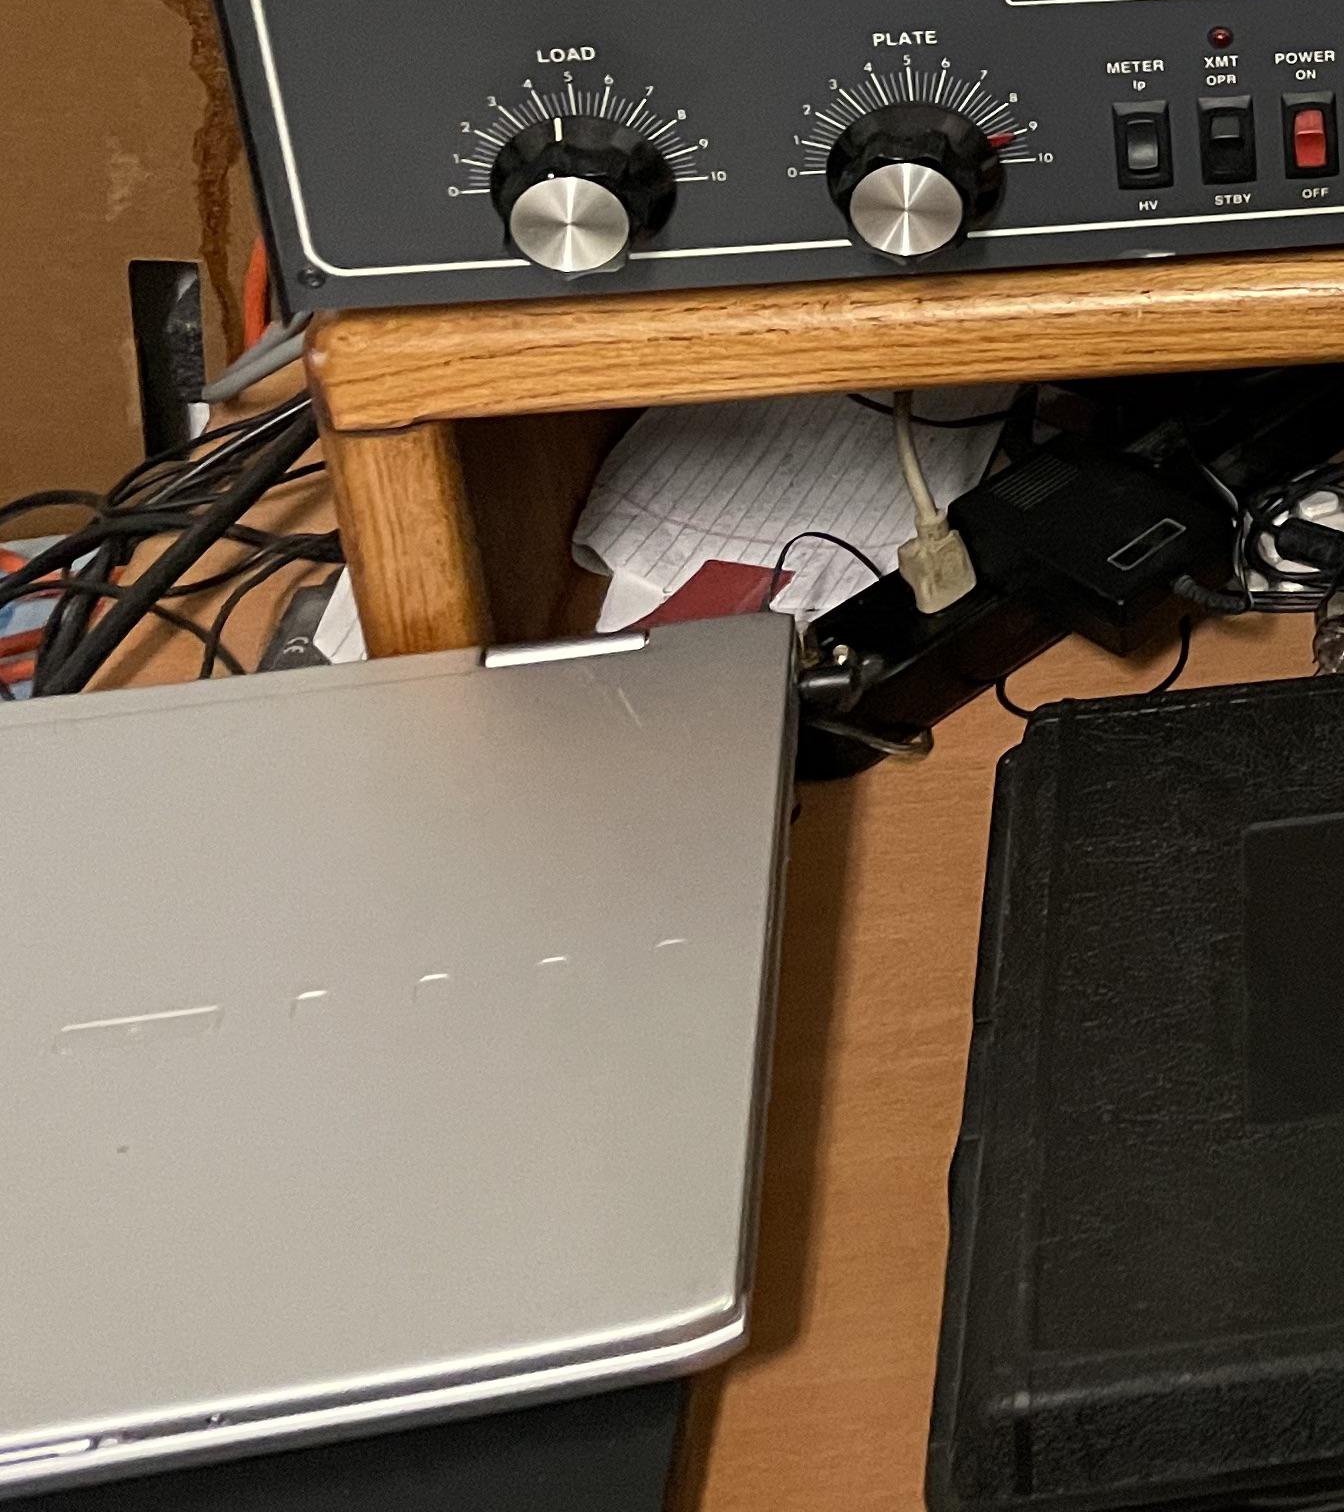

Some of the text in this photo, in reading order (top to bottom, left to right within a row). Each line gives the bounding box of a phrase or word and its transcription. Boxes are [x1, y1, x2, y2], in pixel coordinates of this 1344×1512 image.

[872, 30, 938, 47] PLATE
[536, 46, 596, 64] LOAD
[1204, 54, 1239, 69] XMT
[1274, 50, 1336, 65] POWER
[1106, 59, 1164, 74] METER
[1206, 74, 1237, 87] OPR
[1295, 69, 1317, 81] ON
[1214, 192, 1252, 206] STBY
[1301, 188, 1330, 199] OFF
[1138, 199, 1159, 211] HV
